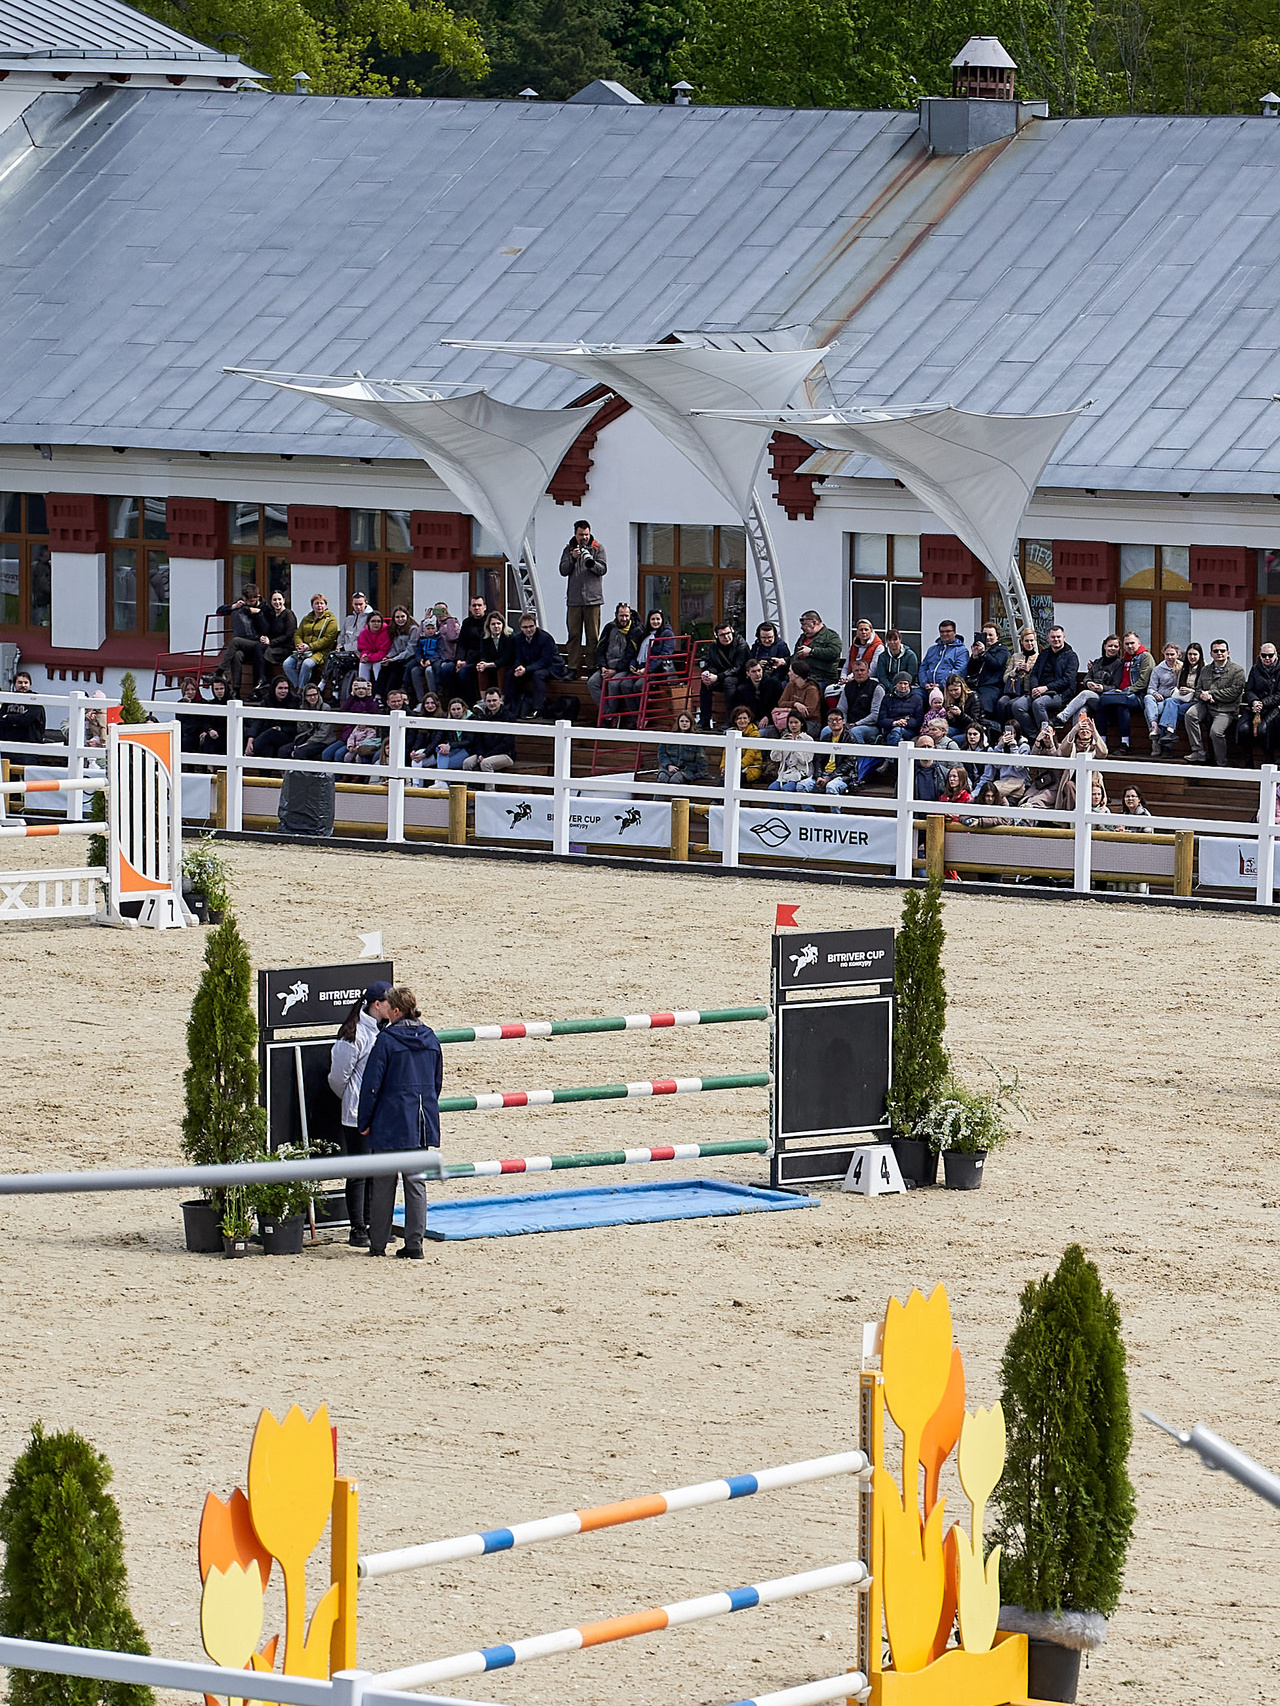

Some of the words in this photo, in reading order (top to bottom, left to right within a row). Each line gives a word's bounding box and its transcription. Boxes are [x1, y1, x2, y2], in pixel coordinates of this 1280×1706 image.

[547, 813, 583, 823] BIVER
[584, 815, 602, 824] CUP
[798, 826, 869, 846] BITRIVER
[827, 952, 866, 963] BITRIVER
[867, 950, 886, 960] CUP
[319, 988, 361, 1001] BITRIVER
[853, 1155, 864, 1185] 4
[881, 1155, 891, 1185] 4
